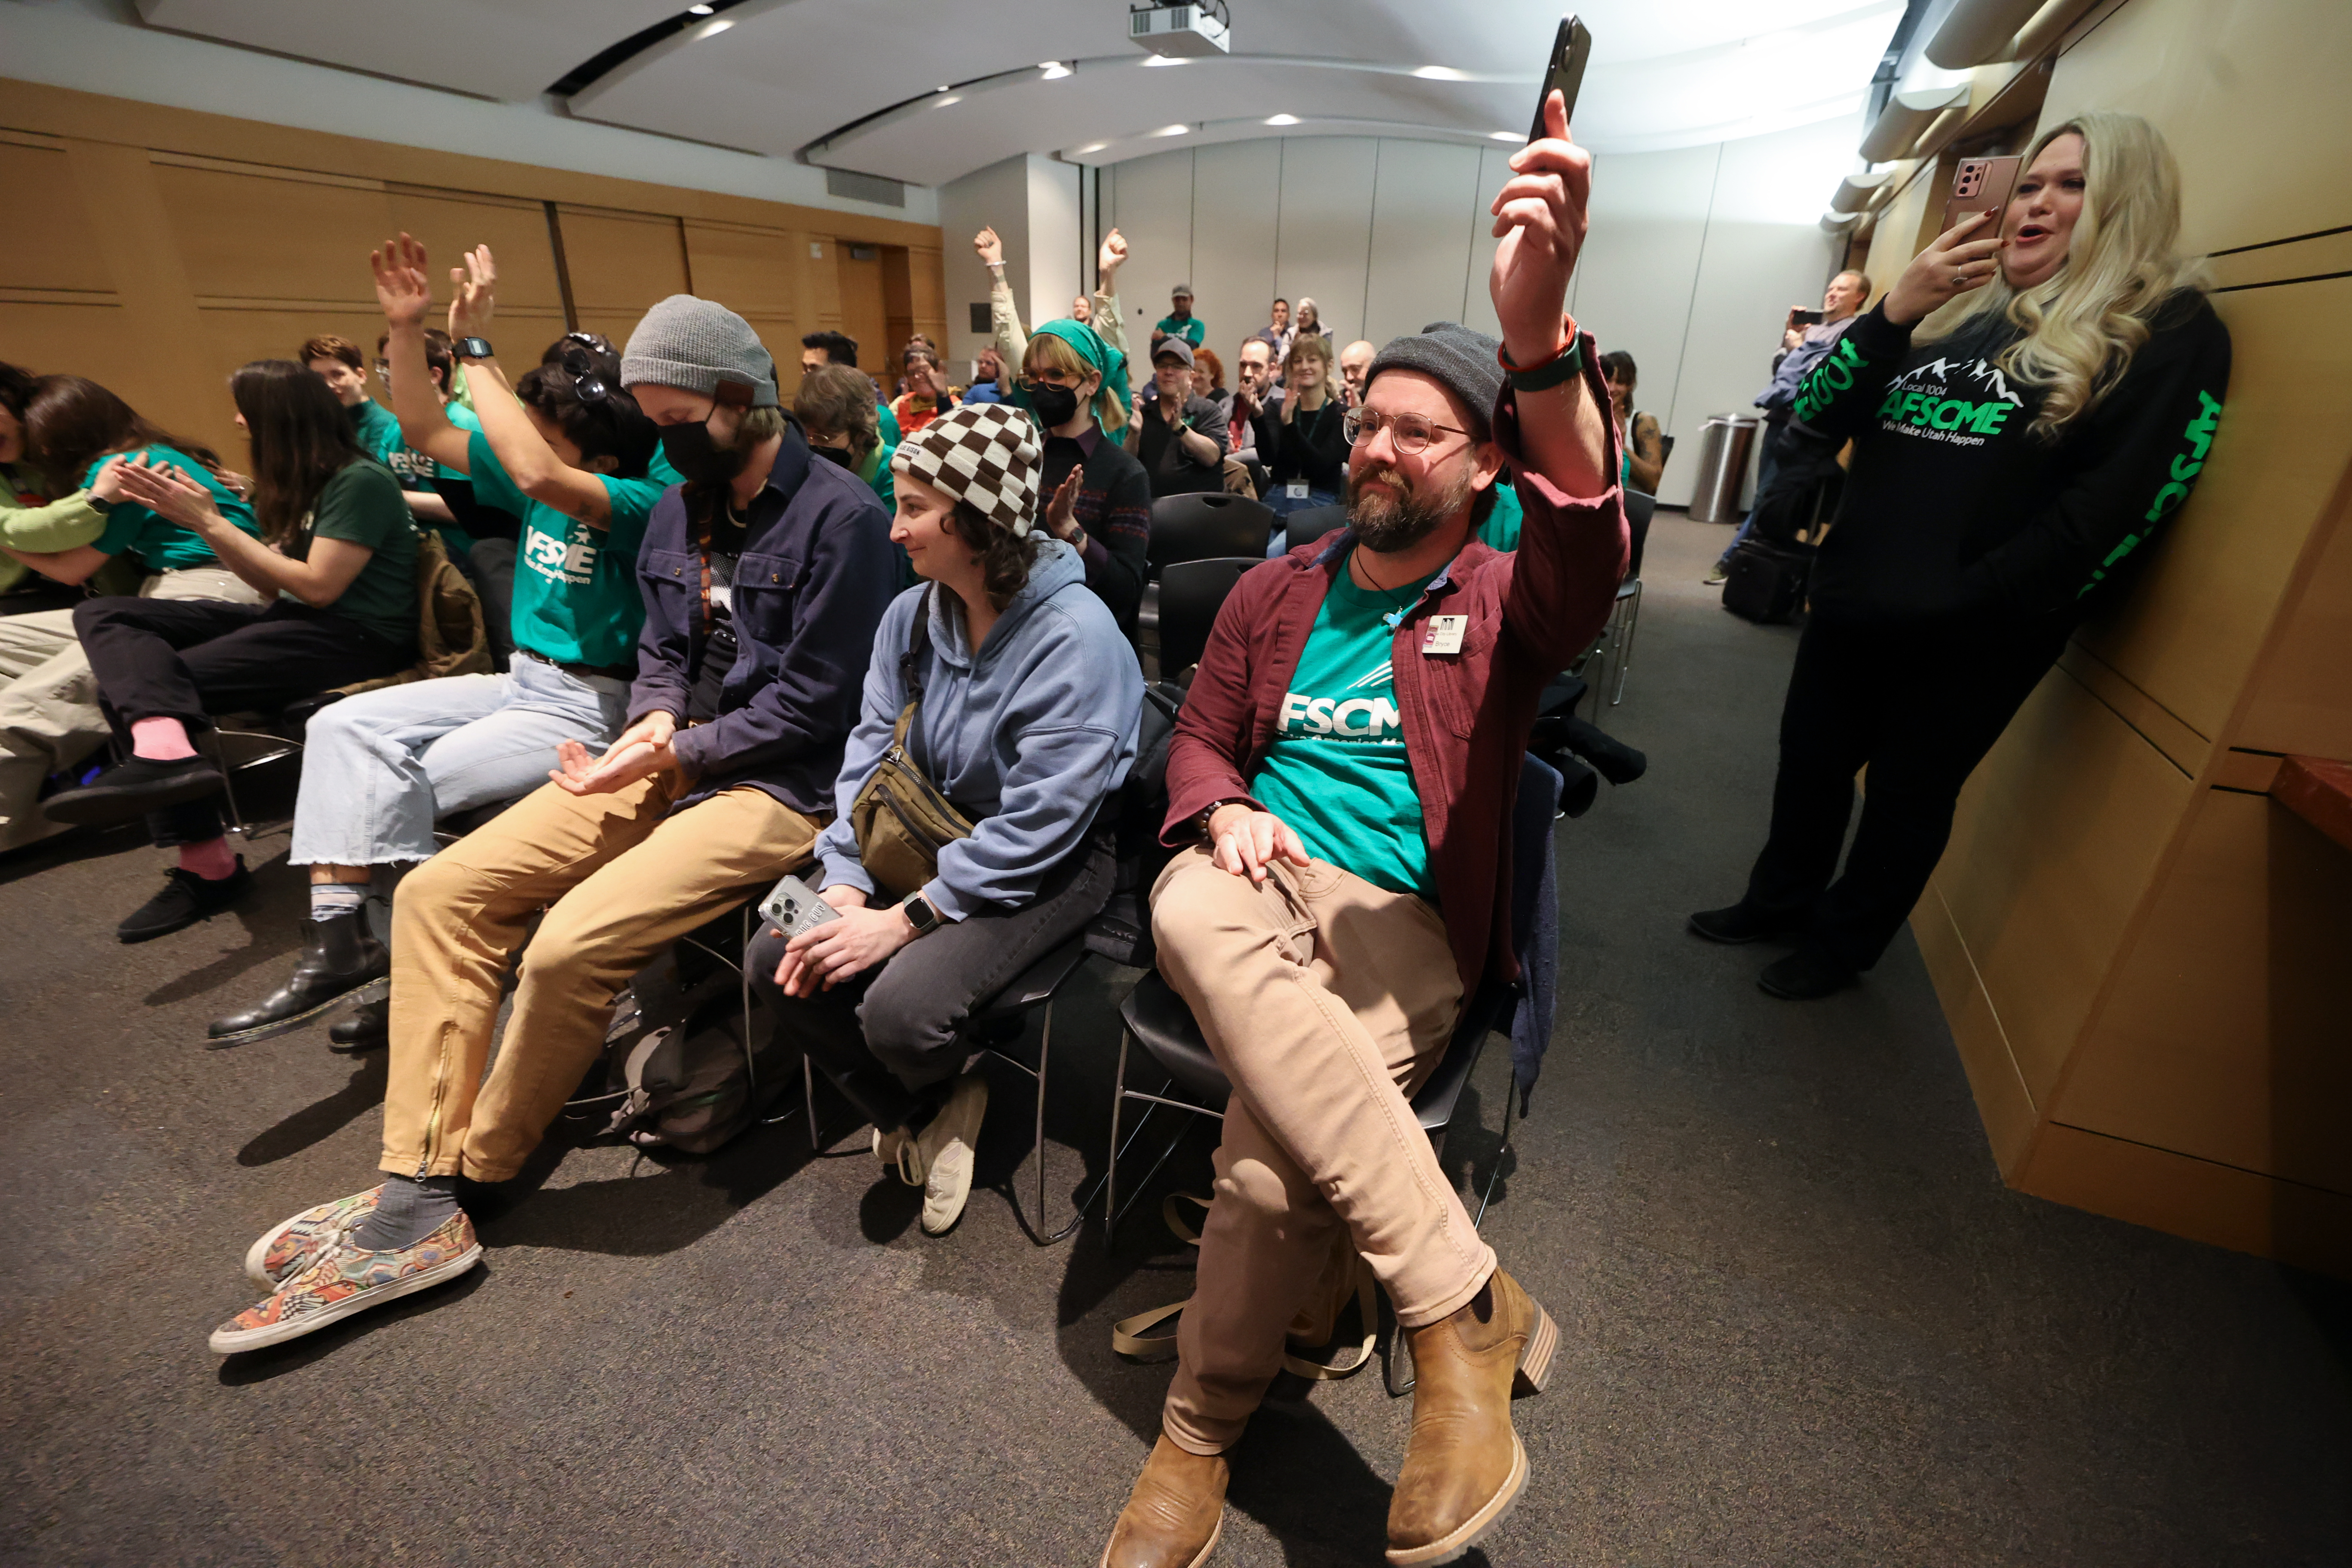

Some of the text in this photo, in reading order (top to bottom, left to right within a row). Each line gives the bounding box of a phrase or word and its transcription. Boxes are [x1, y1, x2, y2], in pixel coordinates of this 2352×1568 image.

[1902, 381, 1948, 396] Local 1004
[1875, 391, 2015, 435] AFSCME
[1883, 420, 1985, 446] We Make Utah Happen
[1277, 692, 1402, 737] FSCM
[808, 902, 825, 922] GUY
